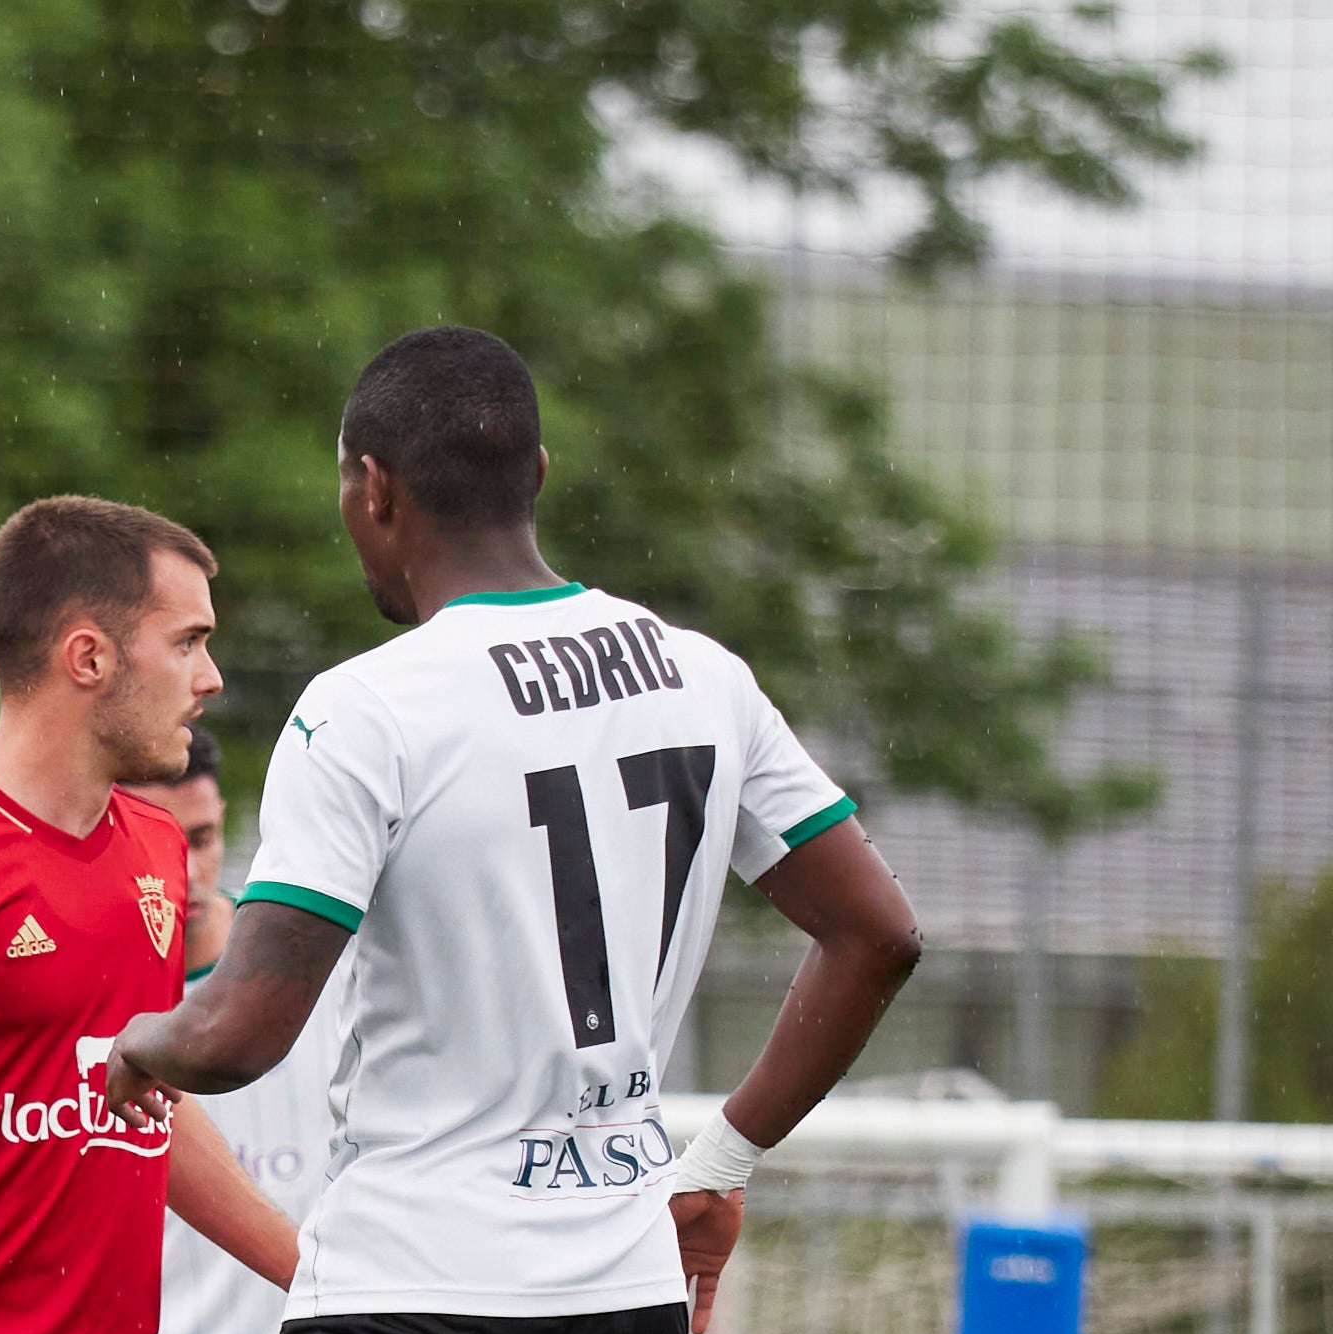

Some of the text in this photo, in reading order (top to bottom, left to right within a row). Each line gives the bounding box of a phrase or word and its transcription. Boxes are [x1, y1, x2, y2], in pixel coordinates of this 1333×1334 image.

[487, 617, 684, 717] CEDRIC
[524, 744, 716, 1050] 17
[6, 937, 57, 958] adidas
[578, 1084, 615, 1113] EL
